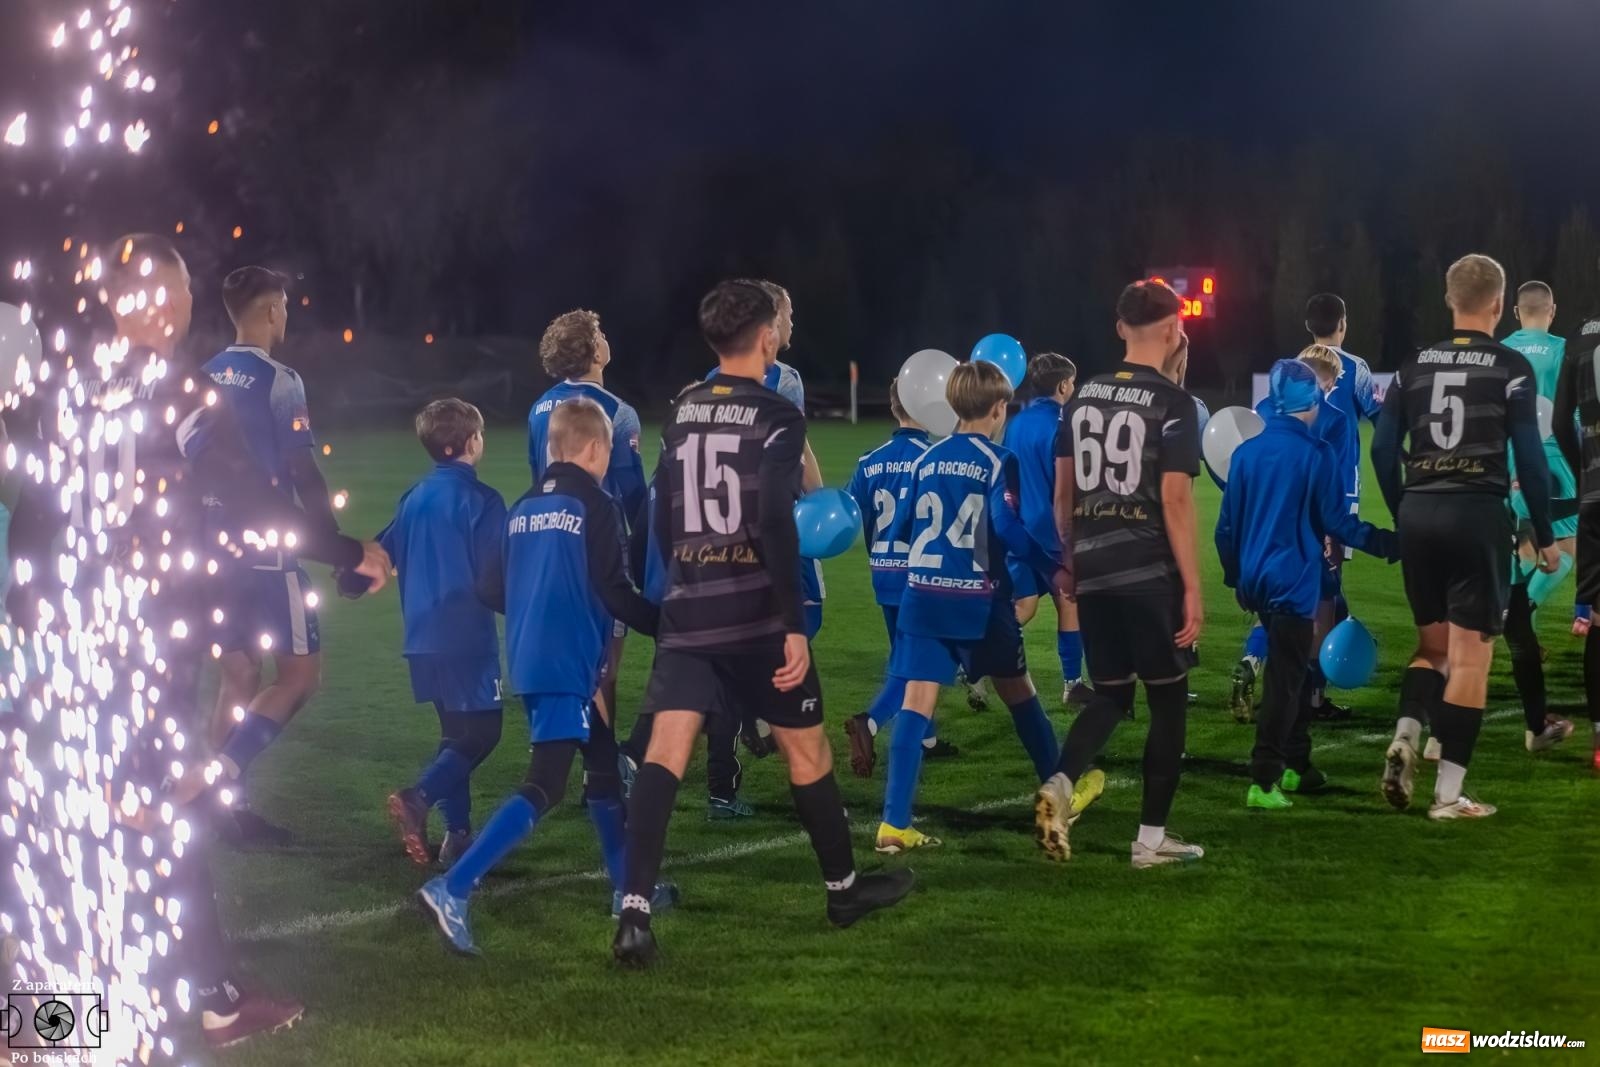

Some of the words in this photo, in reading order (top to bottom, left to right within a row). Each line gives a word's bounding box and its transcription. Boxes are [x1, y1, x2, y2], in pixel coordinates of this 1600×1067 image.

[1417, 347, 1456, 365] GÓRNIK
[1456, 351, 1497, 368] RADLIN
[1078, 380, 1117, 401] GÓRNIK
[1114, 386, 1156, 408] RADLIN
[675, 400, 716, 425] GÓRNIK
[714, 403, 759, 426] RADLIN
[1430, 372, 1468, 450] 5
[1071, 405, 1147, 496] 69
[676, 432, 742, 535] 15
[863, 462, 884, 479] UNIA
[937, 460, 990, 483] RACIBÓRZ
[529, 508, 583, 536] RACIBÓRZ
[908, 490, 989, 572] 24
